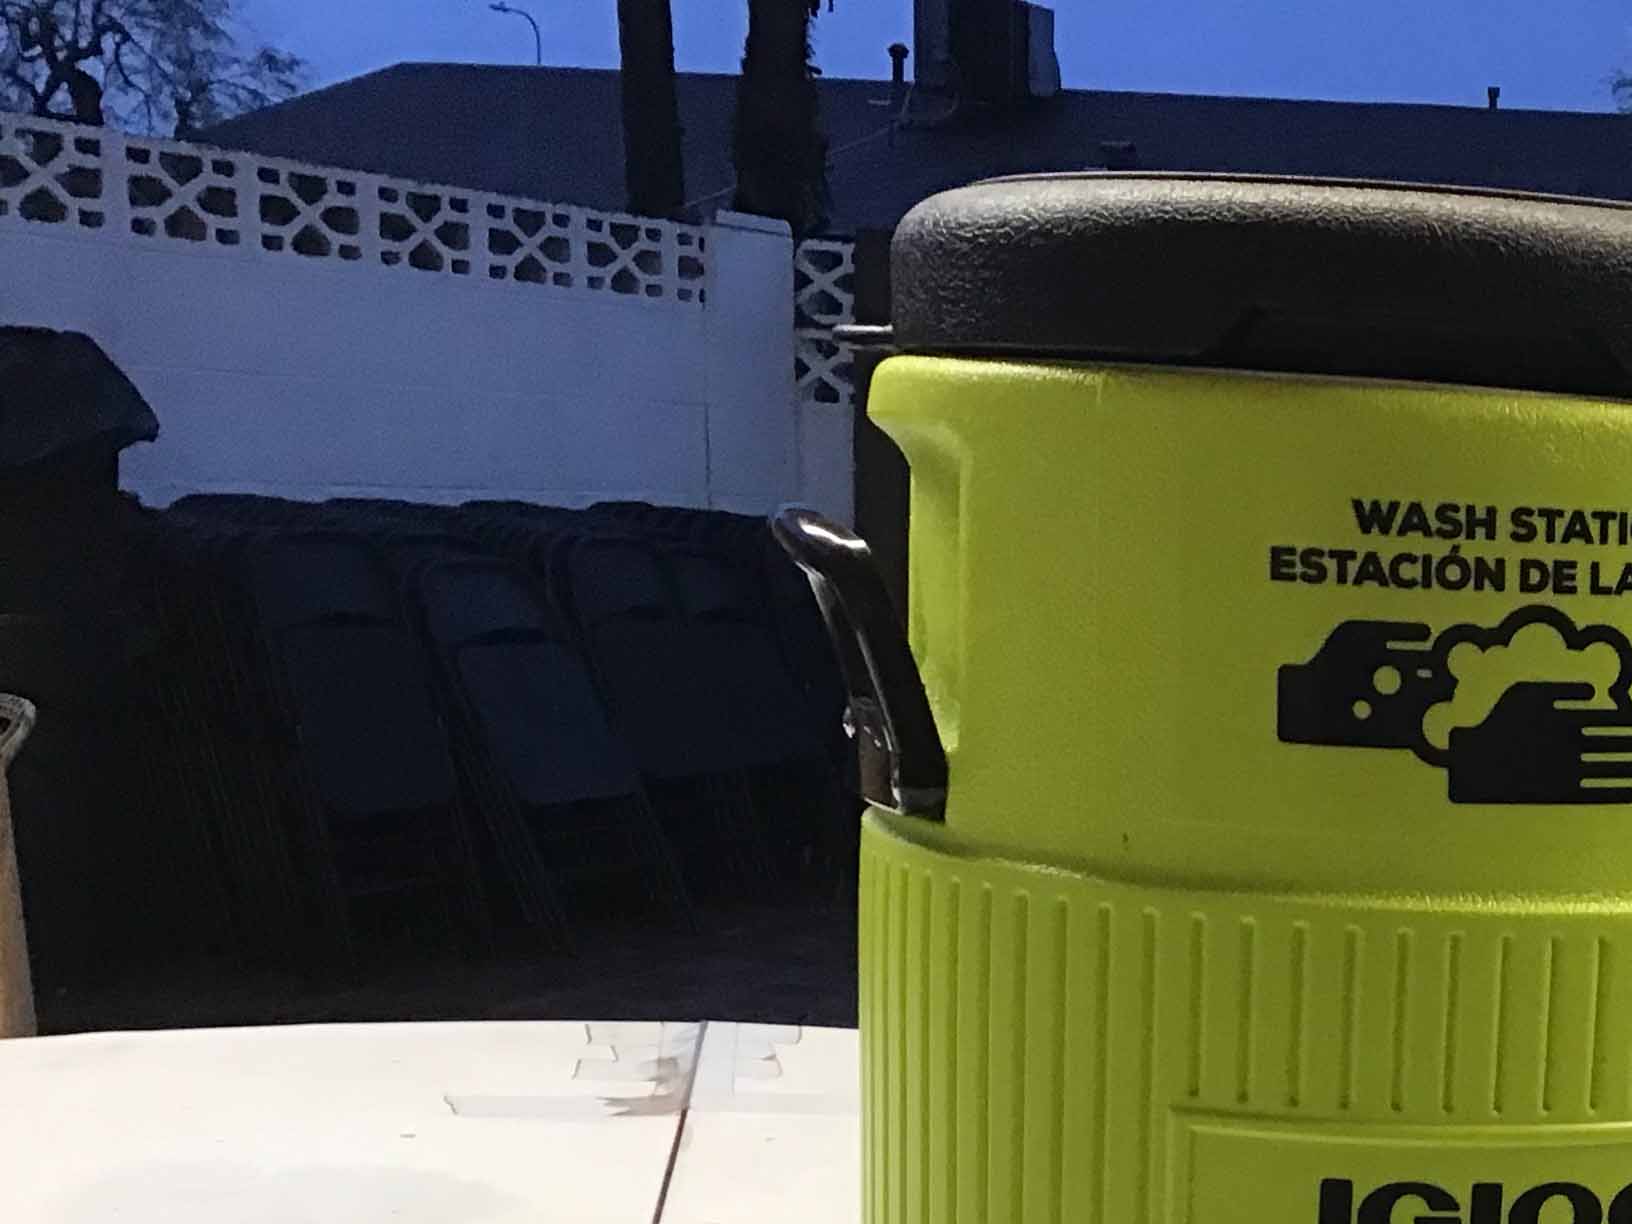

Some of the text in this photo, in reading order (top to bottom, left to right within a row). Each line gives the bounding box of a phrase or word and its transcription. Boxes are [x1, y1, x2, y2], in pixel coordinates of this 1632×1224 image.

[1351, 498, 1498, 541] WASH
[1269, 544, 1506, 592] ESTACIÓN
[1519, 557, 1577, 595] DE
